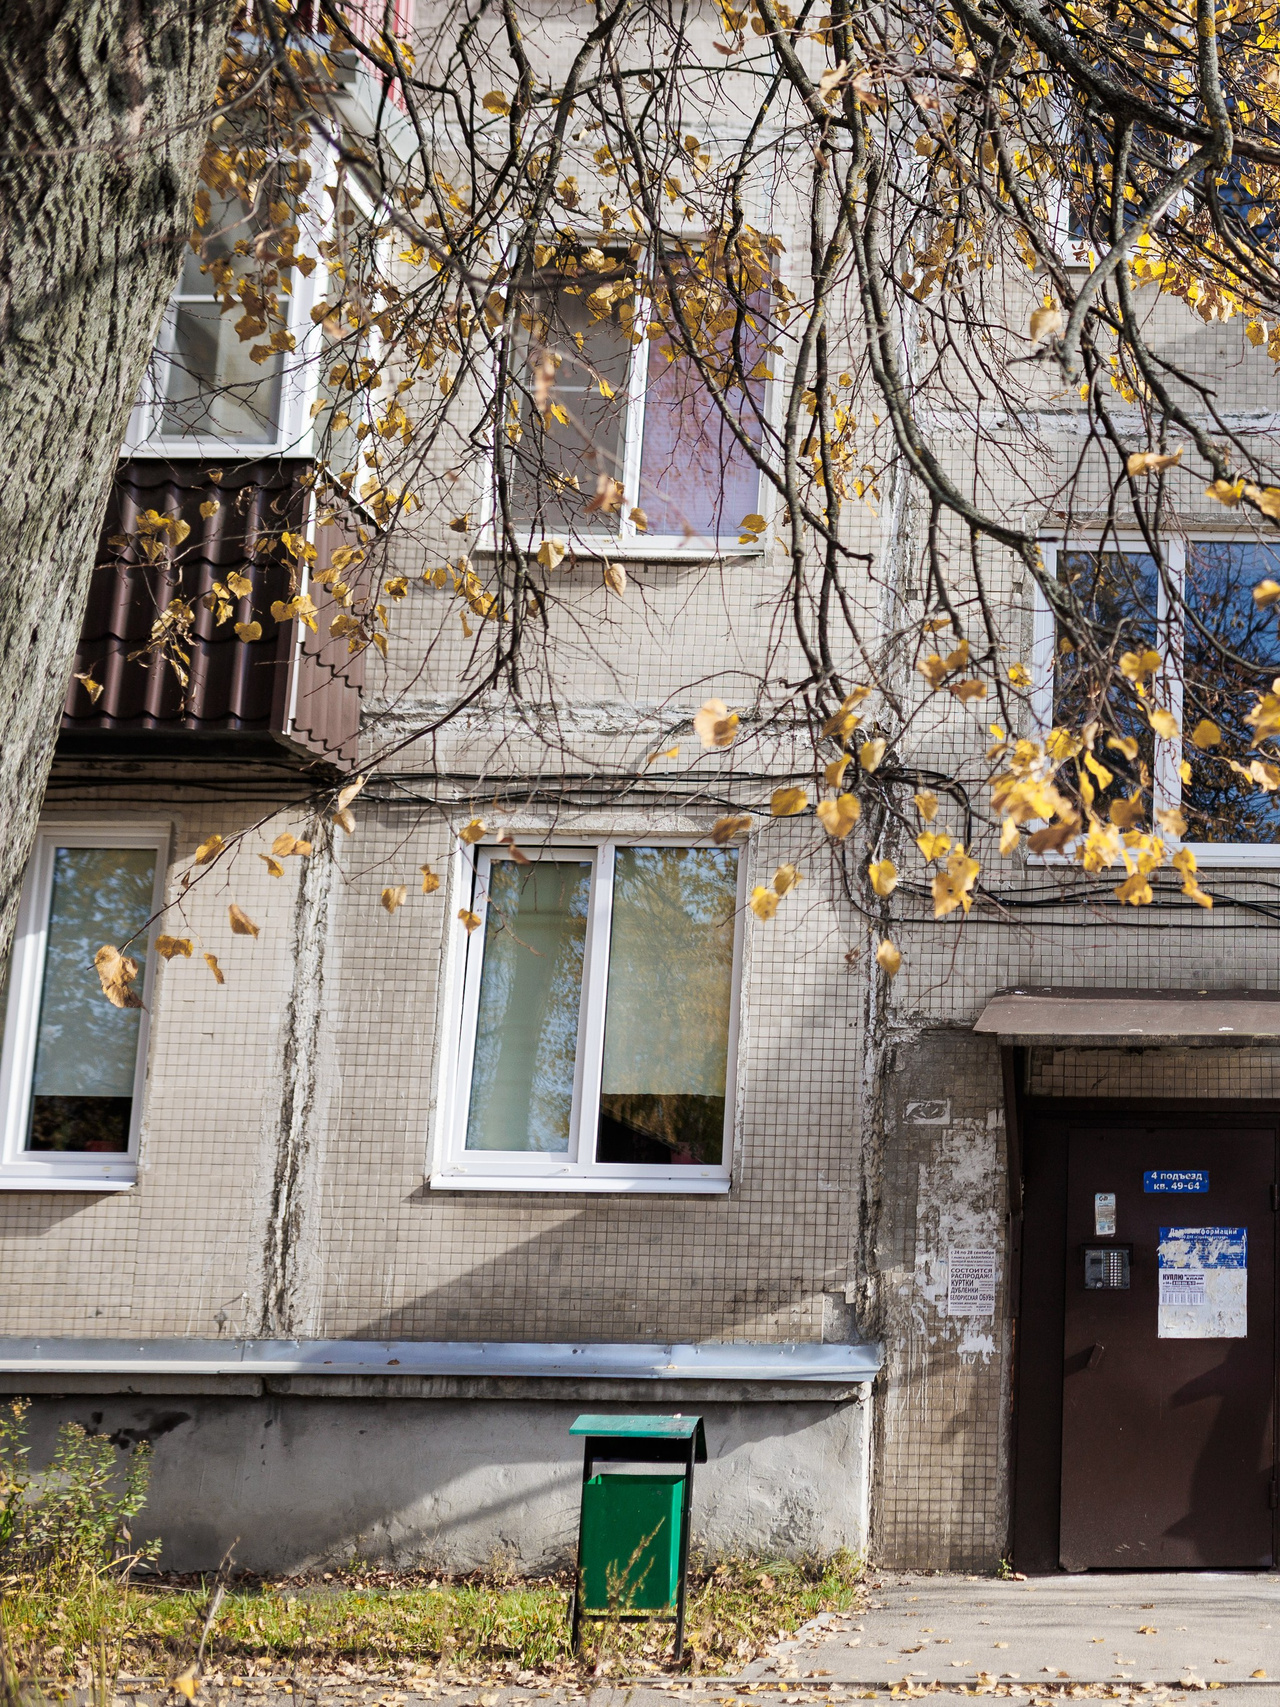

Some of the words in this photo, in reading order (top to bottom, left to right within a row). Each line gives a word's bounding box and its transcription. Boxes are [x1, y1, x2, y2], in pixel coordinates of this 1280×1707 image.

[1151, 1171, 1158, 1180] 4
[1160, 1173, 1203, 1181] подъезд
[1171, 1181, 1200, 1190] 49-64
